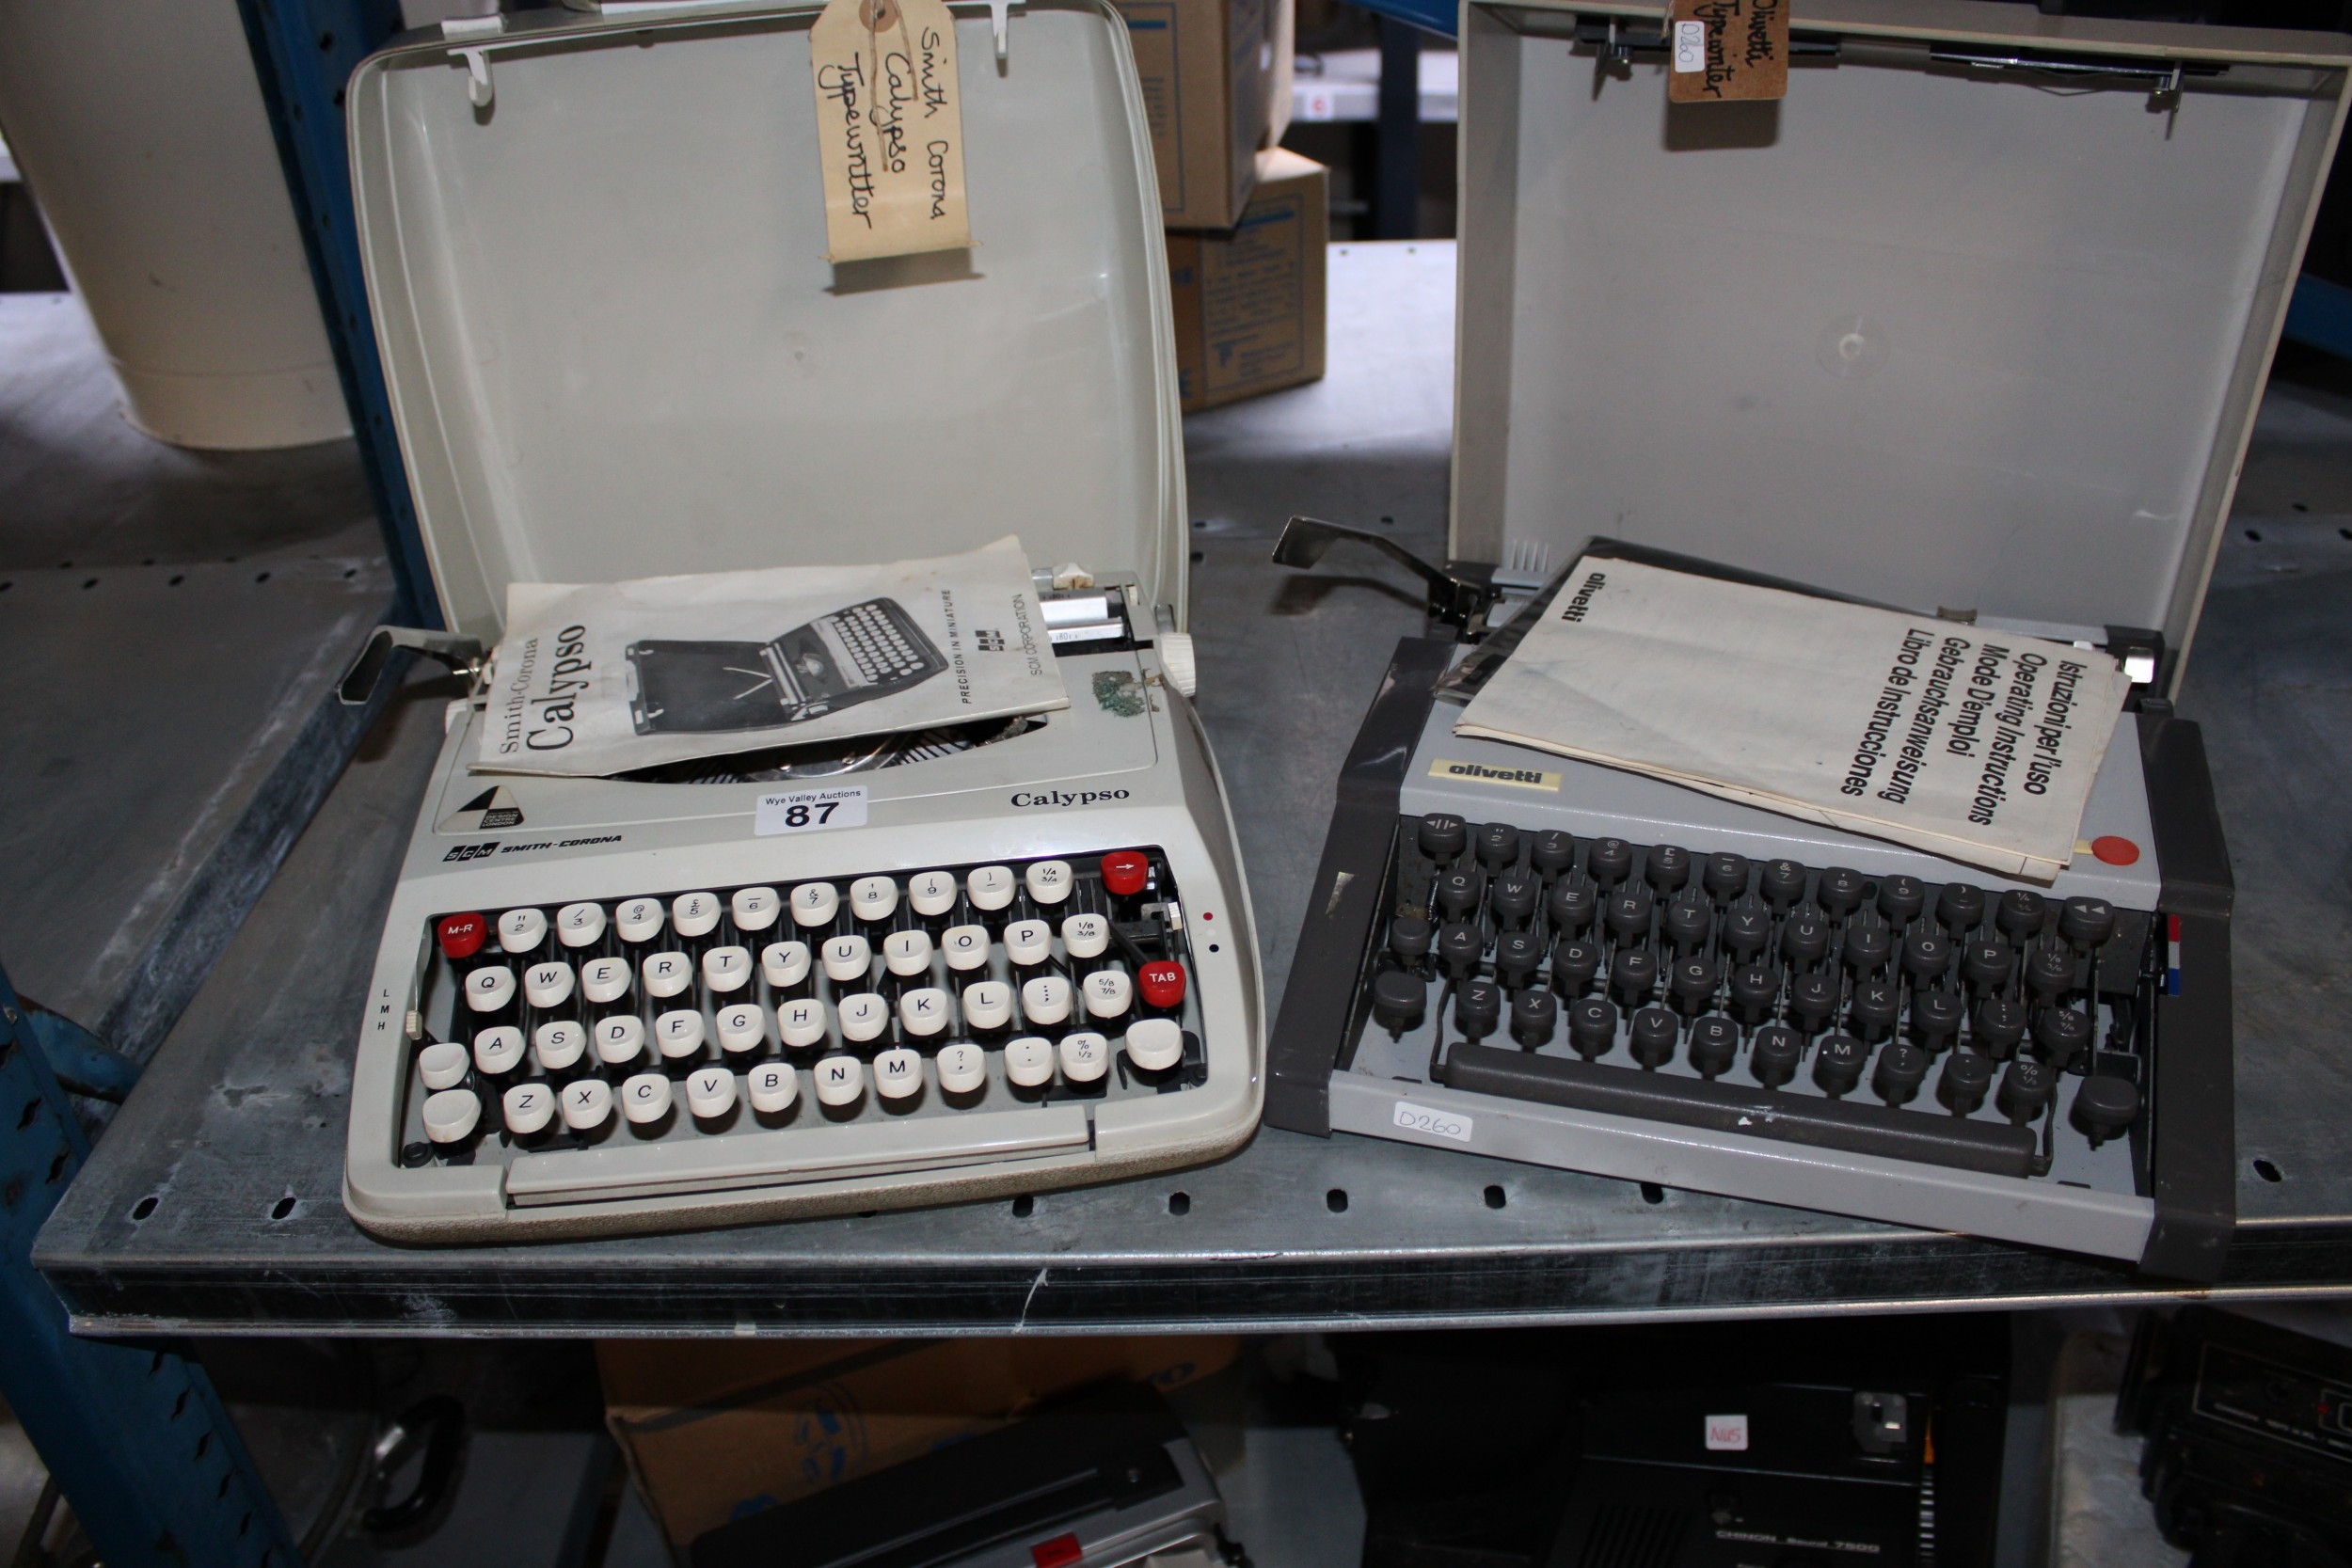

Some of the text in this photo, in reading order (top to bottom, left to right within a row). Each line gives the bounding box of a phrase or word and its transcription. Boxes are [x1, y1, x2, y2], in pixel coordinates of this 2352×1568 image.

[921, 26, 948, 119] Smith
[869, 53, 913, 173] Calypso
[1561, 572, 1606, 623] olivetti
[1012, 593, 1038, 656] CORPORATION
[941, 589, 973, 705] PRECISION IN MINIATURE
[1971, 643, 2010, 687] Mode
[526, 625, 592, 751] Calypso
[2042, 660, 2088, 730] Istruzioni
[1840, 628, 1934, 797] Libro de Instrucciones
[1877, 637, 1971, 804] Gebrauchsanweisung
[1967, 653, 2048, 826] Operating Instructions
[2033, 723, 2062, 751] per
[1449, 764, 1543, 784] olivetti
[765, 790, 862, 806] Wye Valley Auctions
[1010, 788, 1130, 807] Calypso
[785, 801, 840, 828] 87
[444, 844, 498, 862] SCM
[1722, 864, 1733, 873] 6
[1452, 877, 1466, 887] Q
[1837, 879, 1849, 888] 8
[928, 886, 937, 895] 9
[1507, 883, 1523, 894] W
[810, 896, 818, 905] 7
[1565, 892, 1580, 902] E
[690, 907, 699, 915] 5
[1623, 900, 1637, 911] R
[1684, 909, 1696, 919] T
[1740, 916, 1754, 927] Y
[447, 924, 474, 935] M-R
[1021, 929, 1034, 942] P
[1800, 925, 1814, 936] U
[958, 935, 973, 947] O
[1454, 931, 1467, 942] A
[1512, 940, 1525, 950] S
[1921, 942, 1935, 952] O
[778, 951, 791, 963] Y
[838, 945, 852, 958] U
[1568, 947, 1582, 958] D
[1984, 949, 1997, 959] P
[659, 961, 673, 974] R
[720, 955, 733, 968] T
[1629, 957, 1643, 967] F
[596, 967, 612, 979] E
[1689, 965, 1704, 976] G
[481, 976, 496, 988] Q
[539, 971, 558, 983] W
[1149, 972, 1176, 983] TAB
[1749, 974, 1763, 985] H
[383, 989, 390, 998] L
[1810, 983, 1822, 994] J
[980, 991, 994, 1005] L
[1470, 990, 1486, 1001] Z
[1870, 990, 1884, 1002] K
[380, 1005, 390, 1014] M
[916, 998, 931, 1011] K
[1528, 998, 1542, 1009] X
[1933, 1000, 1947, 1010] L
[793, 1008, 808, 1022] H
[855, 1004, 867, 1017] J
[1587, 1007, 1602, 1018] C
[377, 1022, 386, 1031] H
[732, 1014, 746, 1027] G
[1650, 1017, 1663, 1028] V
[611, 1025, 625, 1039] D
[671, 1020, 685, 1034] F
[1709, 1025, 1723, 1037] B
[489, 1037, 502, 1050] A
[550, 1031, 565, 1045] S
[1772, 1036, 1786, 1047] N
[1835, 1043, 1851, 1055] M
[888, 1059, 906, 1073] M
[764, 1073, 779, 1087] B
[831, 1067, 846, 1081] N
[637, 1085, 652, 1099] C
[703, 1079, 718, 1093] V
[518, 1094, 534, 1109] Z
[578, 1090, 593, 1104] X
